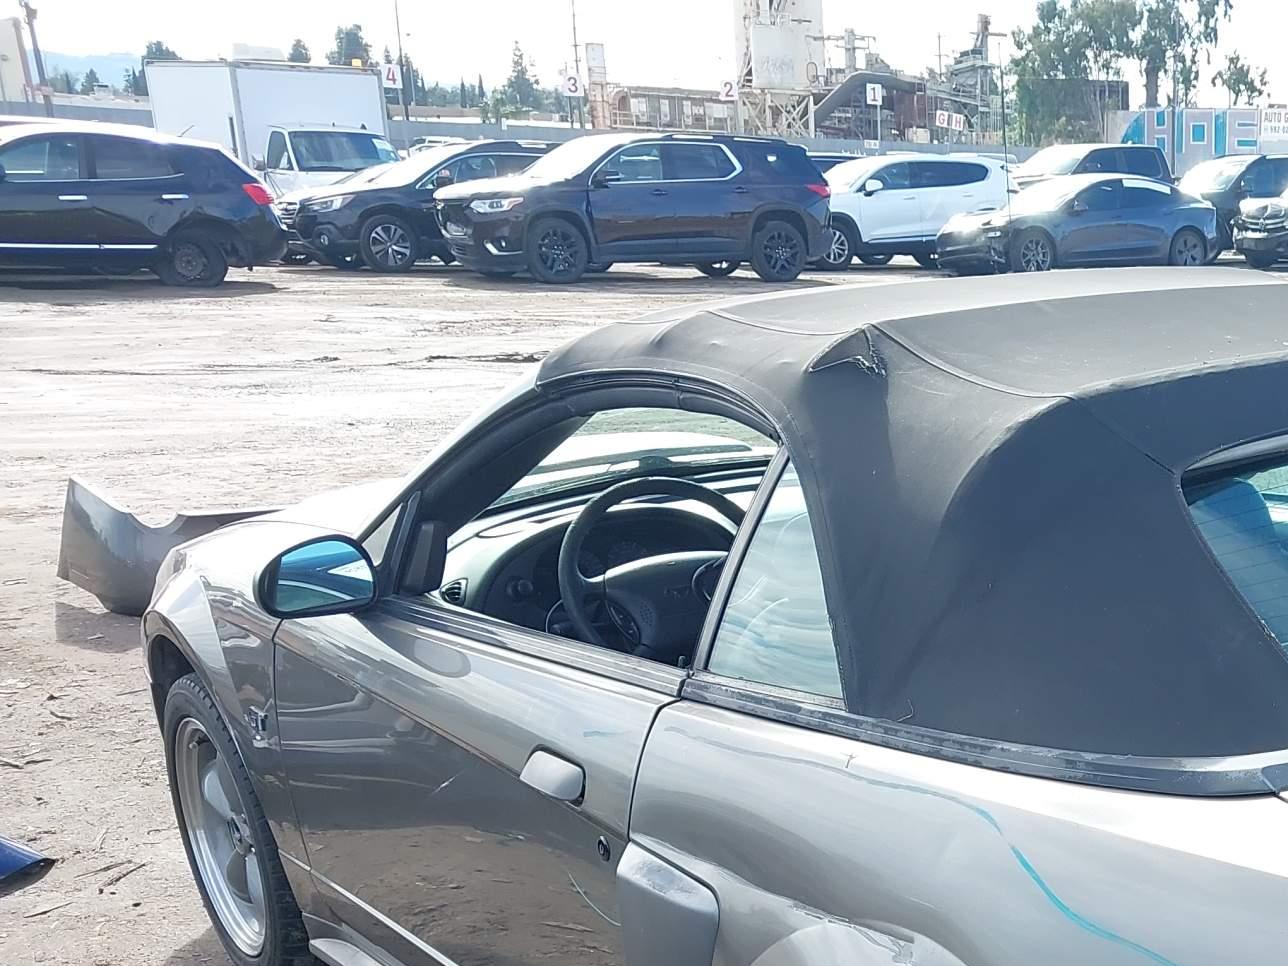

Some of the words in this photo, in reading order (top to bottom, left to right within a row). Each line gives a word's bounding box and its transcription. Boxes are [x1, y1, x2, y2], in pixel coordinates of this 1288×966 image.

[385, 67, 396, 85] 4
[567, 76, 578, 93] 3
[723, 81, 734, 97] 2
[870, 86, 877, 102] 1
[938, 113, 945, 125] G
[954, 117, 961, 128] H
[1264, 112, 1282, 123] AUTO
